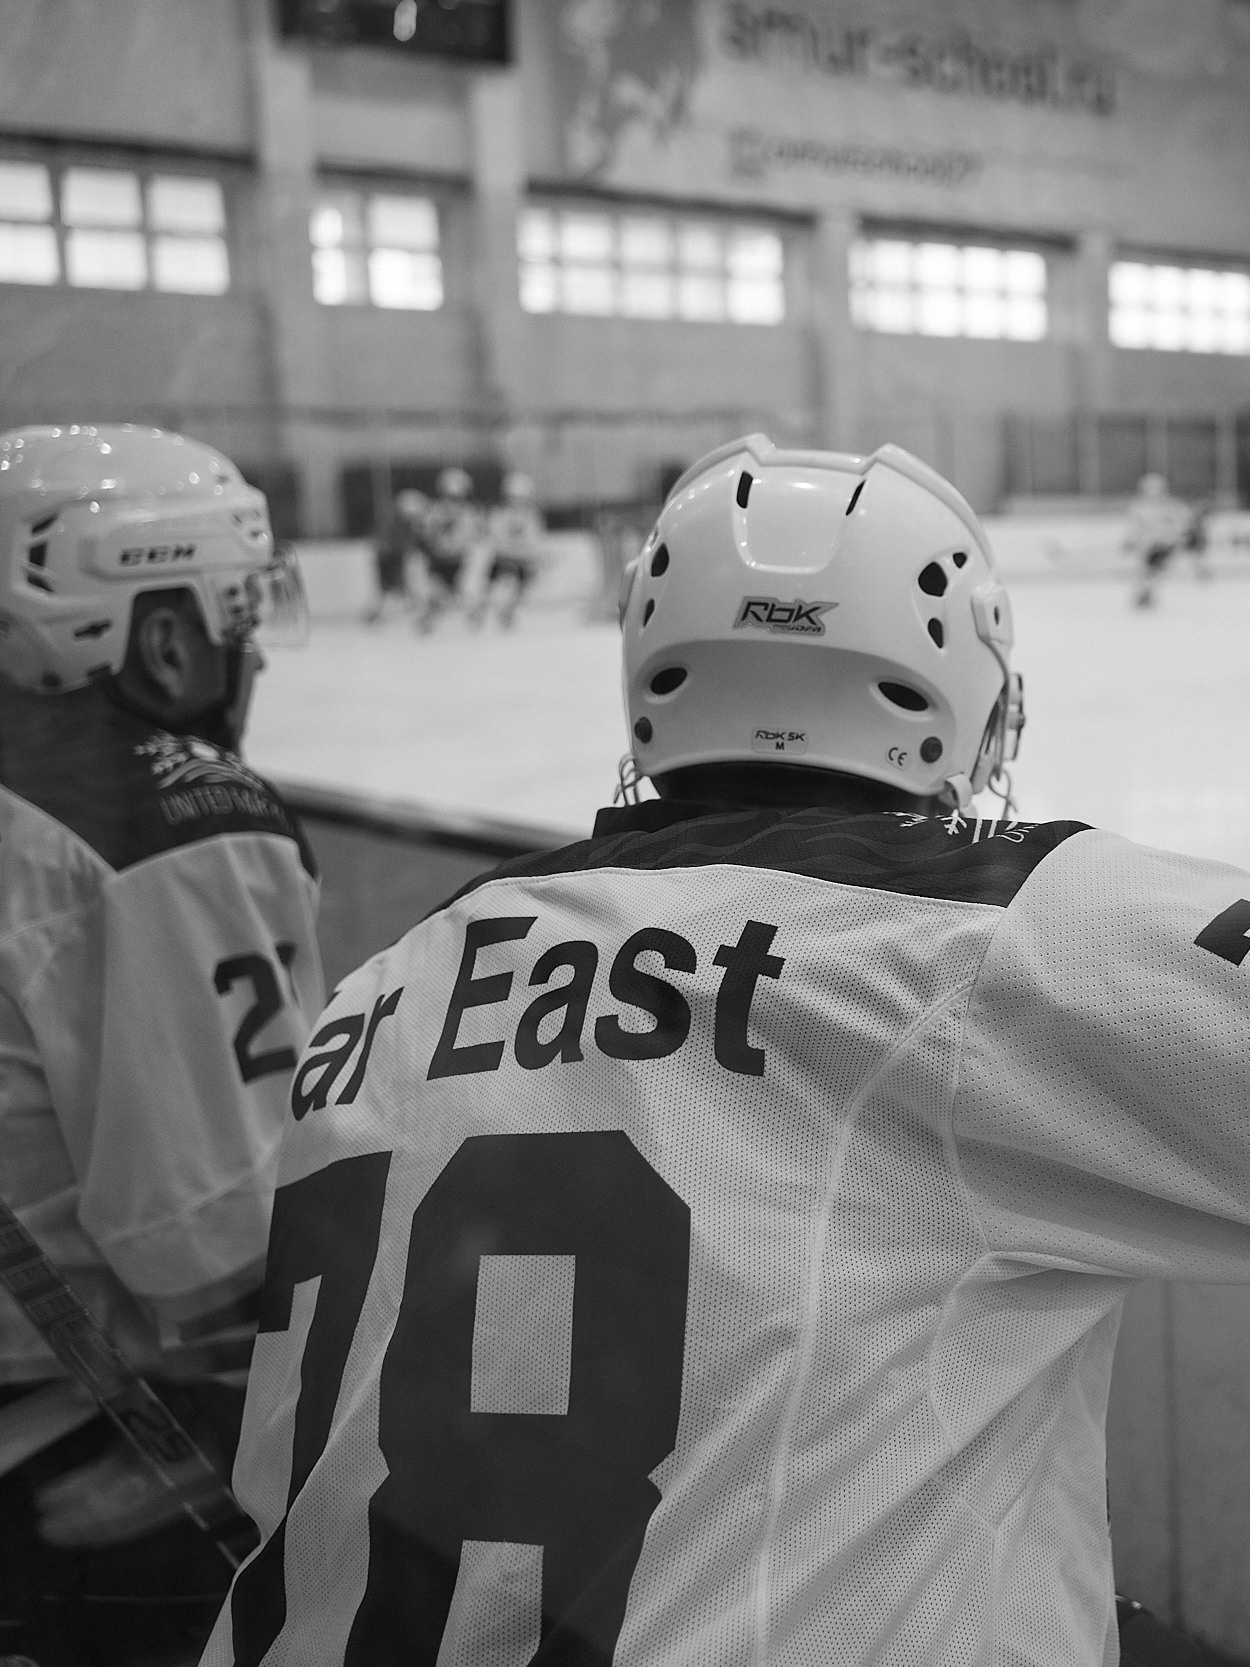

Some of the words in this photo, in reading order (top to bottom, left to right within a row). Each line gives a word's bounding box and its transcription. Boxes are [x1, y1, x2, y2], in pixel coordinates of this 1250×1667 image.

[120, 543, 196, 566] CCM
[775, 742, 785, 750] M
[788, 732, 805, 742] 5K
[291, 985, 404, 1121] ar
[427, 915, 786, 1081] East
[232, 1130, 692, 1667] 78
